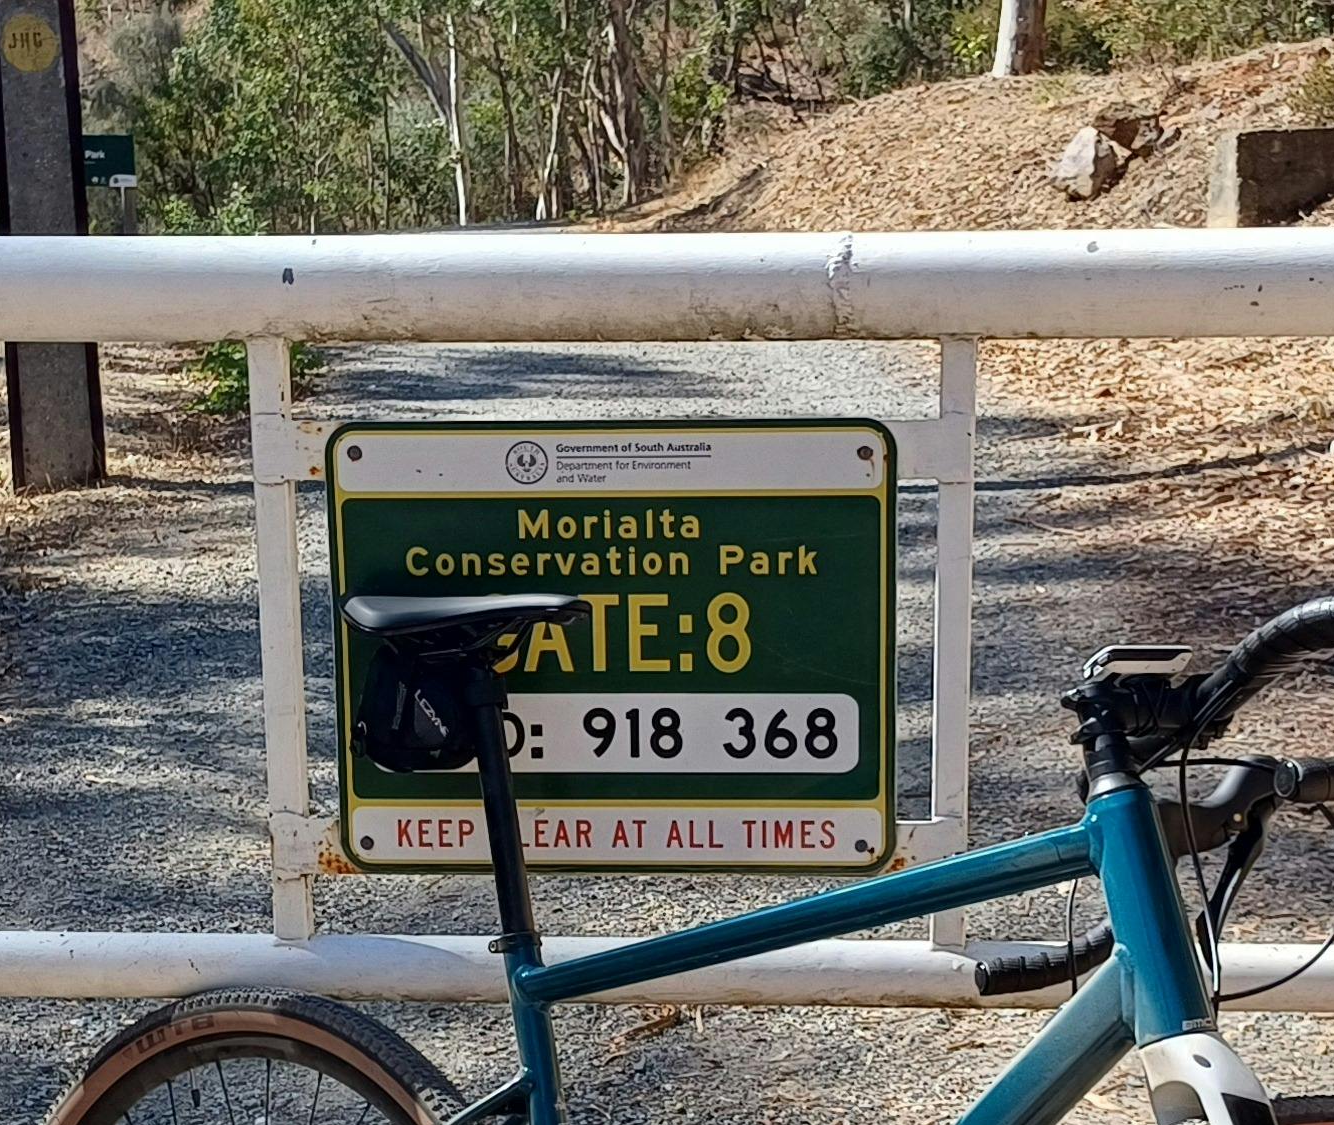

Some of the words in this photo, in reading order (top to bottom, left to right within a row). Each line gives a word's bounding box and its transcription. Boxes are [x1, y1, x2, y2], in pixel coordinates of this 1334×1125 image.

[83, 149, 106, 160] Park
[555, 443, 618, 453] Government
[621, 443, 633, 452] of
[634, 442, 664, 452] South
[666, 442, 712, 452] Australia
[555, 460, 613, 473] Department
[615, 460, 630, 471] for
[632, 459, 692, 470] Environment
[555, 473, 575, 484] and
[577, 473, 607, 484] Water
[518, 509, 701, 539] Morialta
[405, 546, 690, 577] Conservation
[718, 545, 818, 576] Park
[582, 707, 685, 759] 918
[722, 707, 839, 760] 368
[396, 819, 474, 849] KEEP
[611, 820, 648, 849] AT
[666, 820, 724, 849] ALL
[742, 820, 837, 849] TIMES
